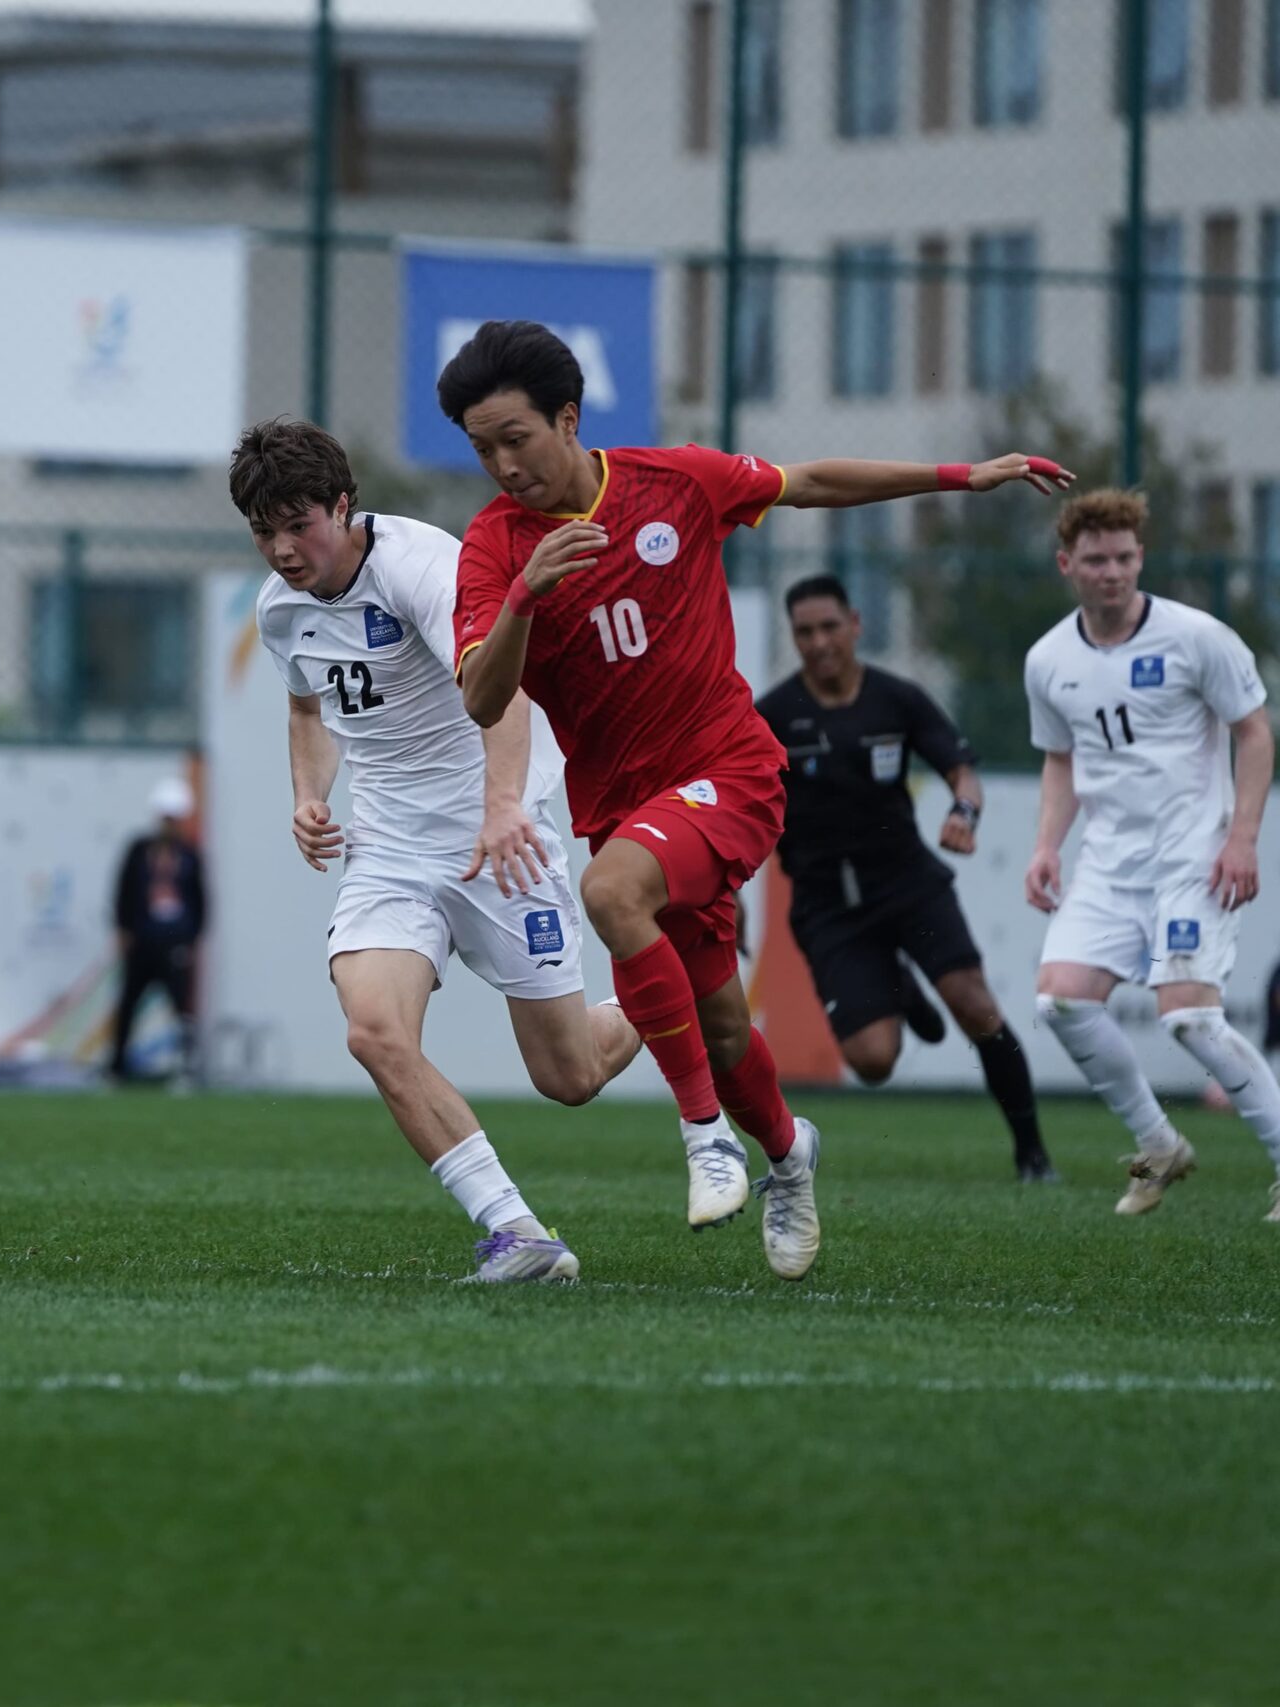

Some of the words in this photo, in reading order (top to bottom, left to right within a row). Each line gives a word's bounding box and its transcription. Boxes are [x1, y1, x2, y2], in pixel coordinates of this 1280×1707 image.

[589, 598, 648, 663] 10
[327, 661, 384, 715] 22
[1095, 704, 1134, 750] 11
